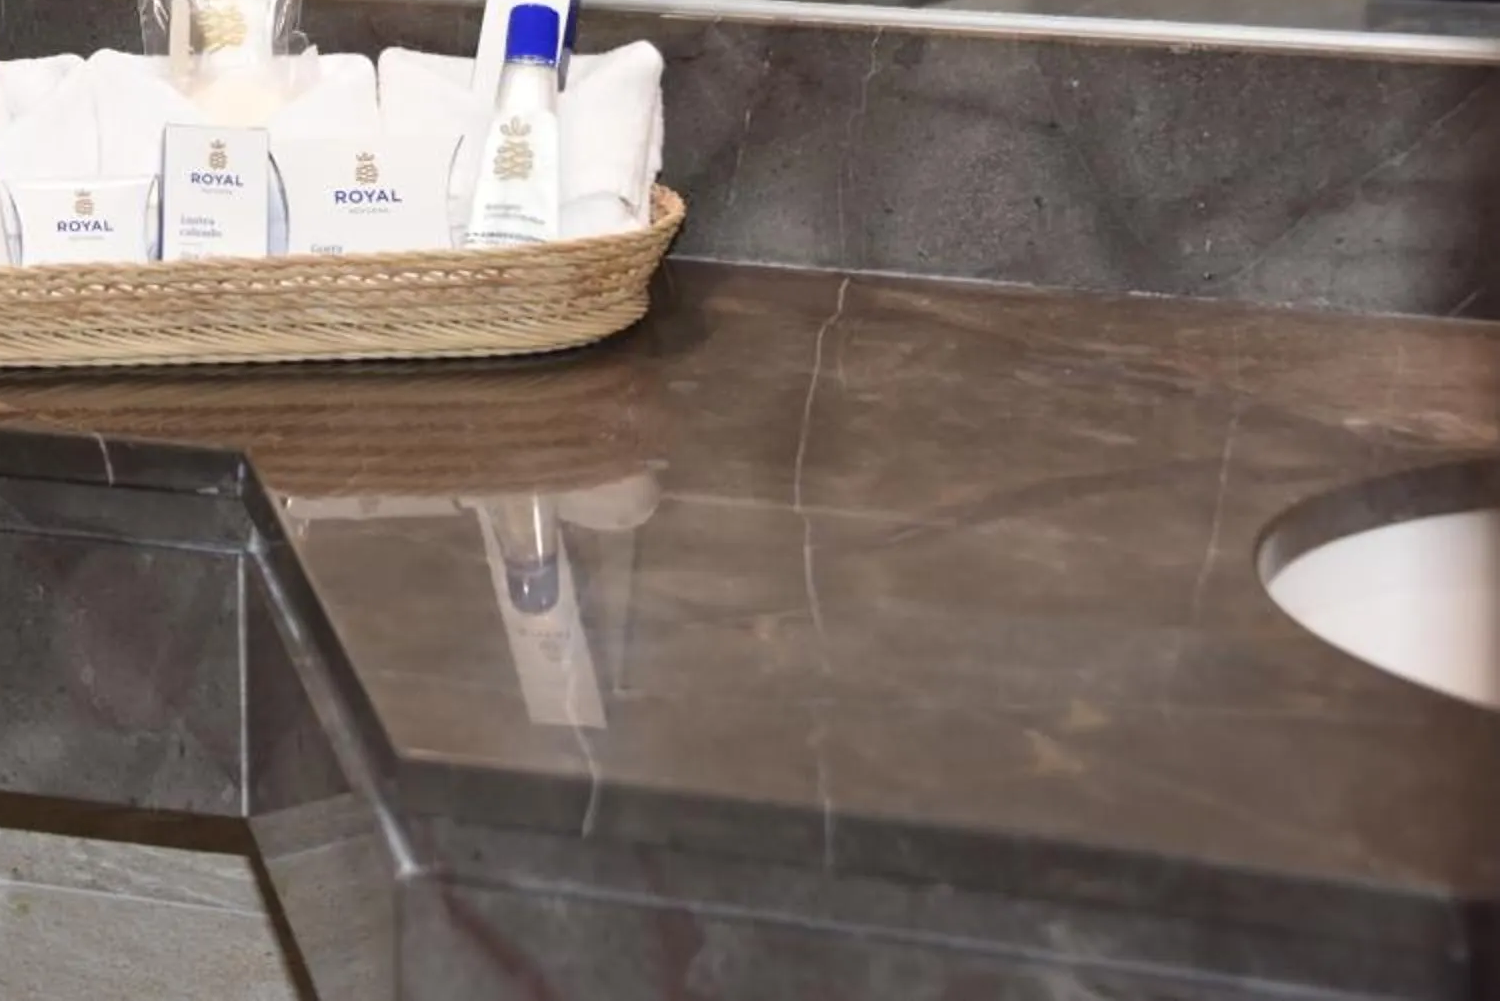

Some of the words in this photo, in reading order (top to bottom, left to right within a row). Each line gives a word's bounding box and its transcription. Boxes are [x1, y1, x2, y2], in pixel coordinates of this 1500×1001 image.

[190, 171, 244, 187] ROYAL
[334, 189, 403, 204] ROYAL
[56, 219, 114, 232] ROYAL
